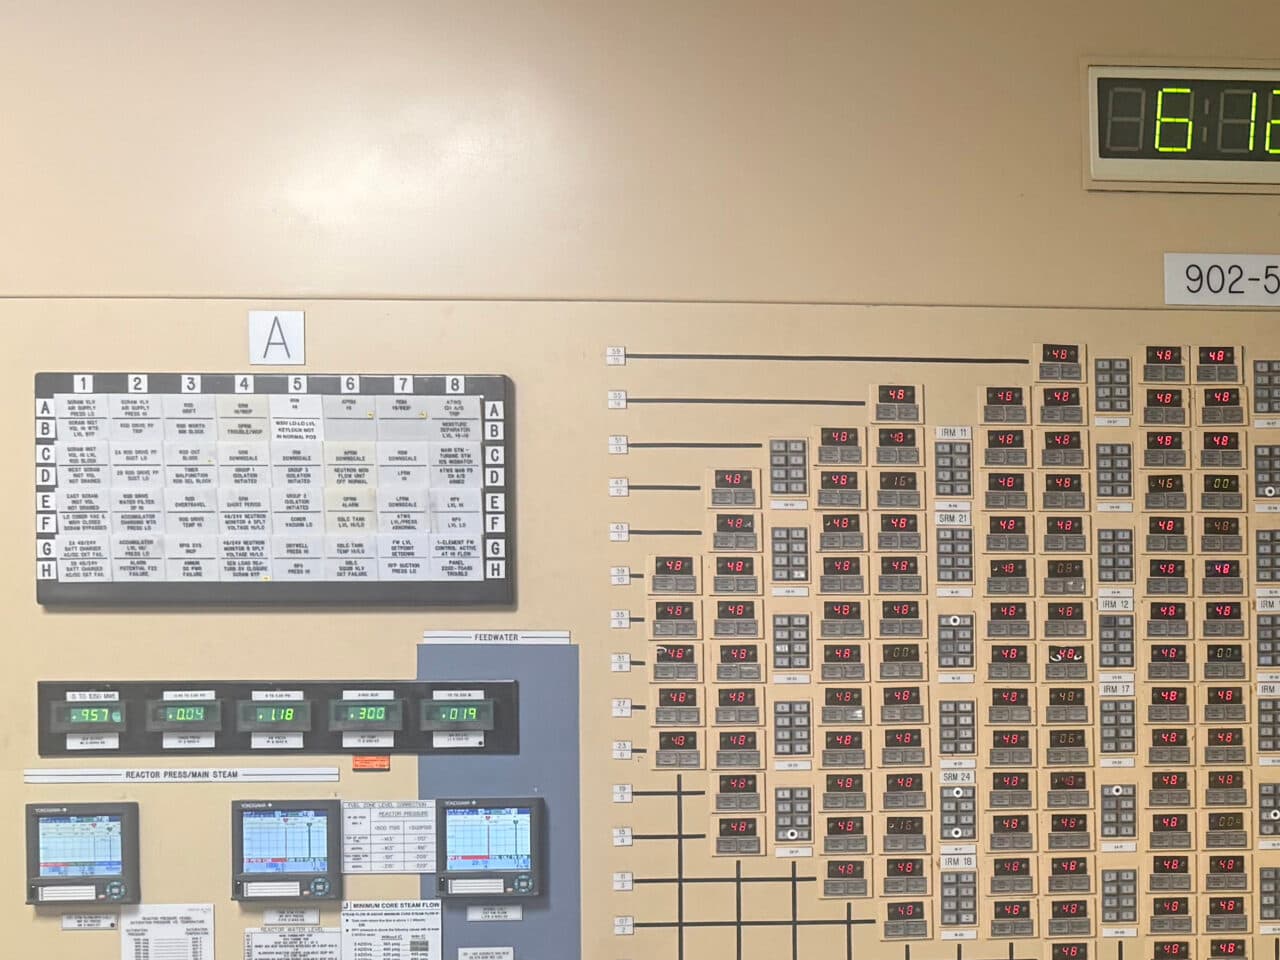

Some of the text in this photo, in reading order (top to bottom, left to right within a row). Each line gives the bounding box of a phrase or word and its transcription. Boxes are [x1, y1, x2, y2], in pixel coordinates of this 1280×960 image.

[1154, 87, 1194, 153] 6
[1185, 263, 1280, 295] 902-5
[262, 315, 291, 359] A
[1052, 349, 1068, 360] 48
[1156, 350, 1173, 361] 48
[1209, 350, 1225, 362] 48
[80, 376, 86, 391] 1
[133, 376, 142, 391] 2
[186, 376, 196, 391] 3
[239, 377, 249, 391] 4
[292, 376, 302, 391] 5
[345, 376, 355, 391] 6
[399, 377, 408, 392] 7
[450, 377, 460, 392] 8
[889, 389, 906, 401] 48
[40, 400, 51, 415] A
[489, 403, 499, 417] A
[40, 421, 50, 436] B
[490, 423, 499, 438] B
[941, 428, 967, 437] IRM 11
[832, 431, 849, 443] 48
[41, 447, 51, 461] C
[490, 448, 500, 463] C
[41, 468, 51, 483] D
[490, 470, 499, 484] D
[725, 473, 742, 485] 48
[41, 494, 51, 509] E
[490, 495, 500, 510] E
[41, 516, 51, 531] F
[490, 516, 500, 531] F
[939, 513, 967, 523] SRM 21
[42, 541, 52, 556] G
[490, 541, 500, 556] G
[41, 563, 52, 578] H
[491, 562, 501, 577] H
[666, 560, 683, 572] 48
[1102, 599, 1129, 609] IRM 12
[1260, 600, 1275, 609] IRM
[474, 633, 519, 642] FEEDWATER
[1002, 647, 1018, 659] 48
[1103, 684, 1131, 694] IRM 17
[1261, 684, 1276, 694] IRM
[1161, 691, 1178, 702] 48
[896, 732, 912, 744] 48
[125, 770, 238, 779] REACTOR PRESS/MAIN STEAM
[943, 772, 971, 782] SRM 24
[730, 820, 747, 833] 48
[944, 856, 973, 866] IRM 18
[1062, 946, 1078, 957] 48
[1220, 943, 1236, 955] 48
